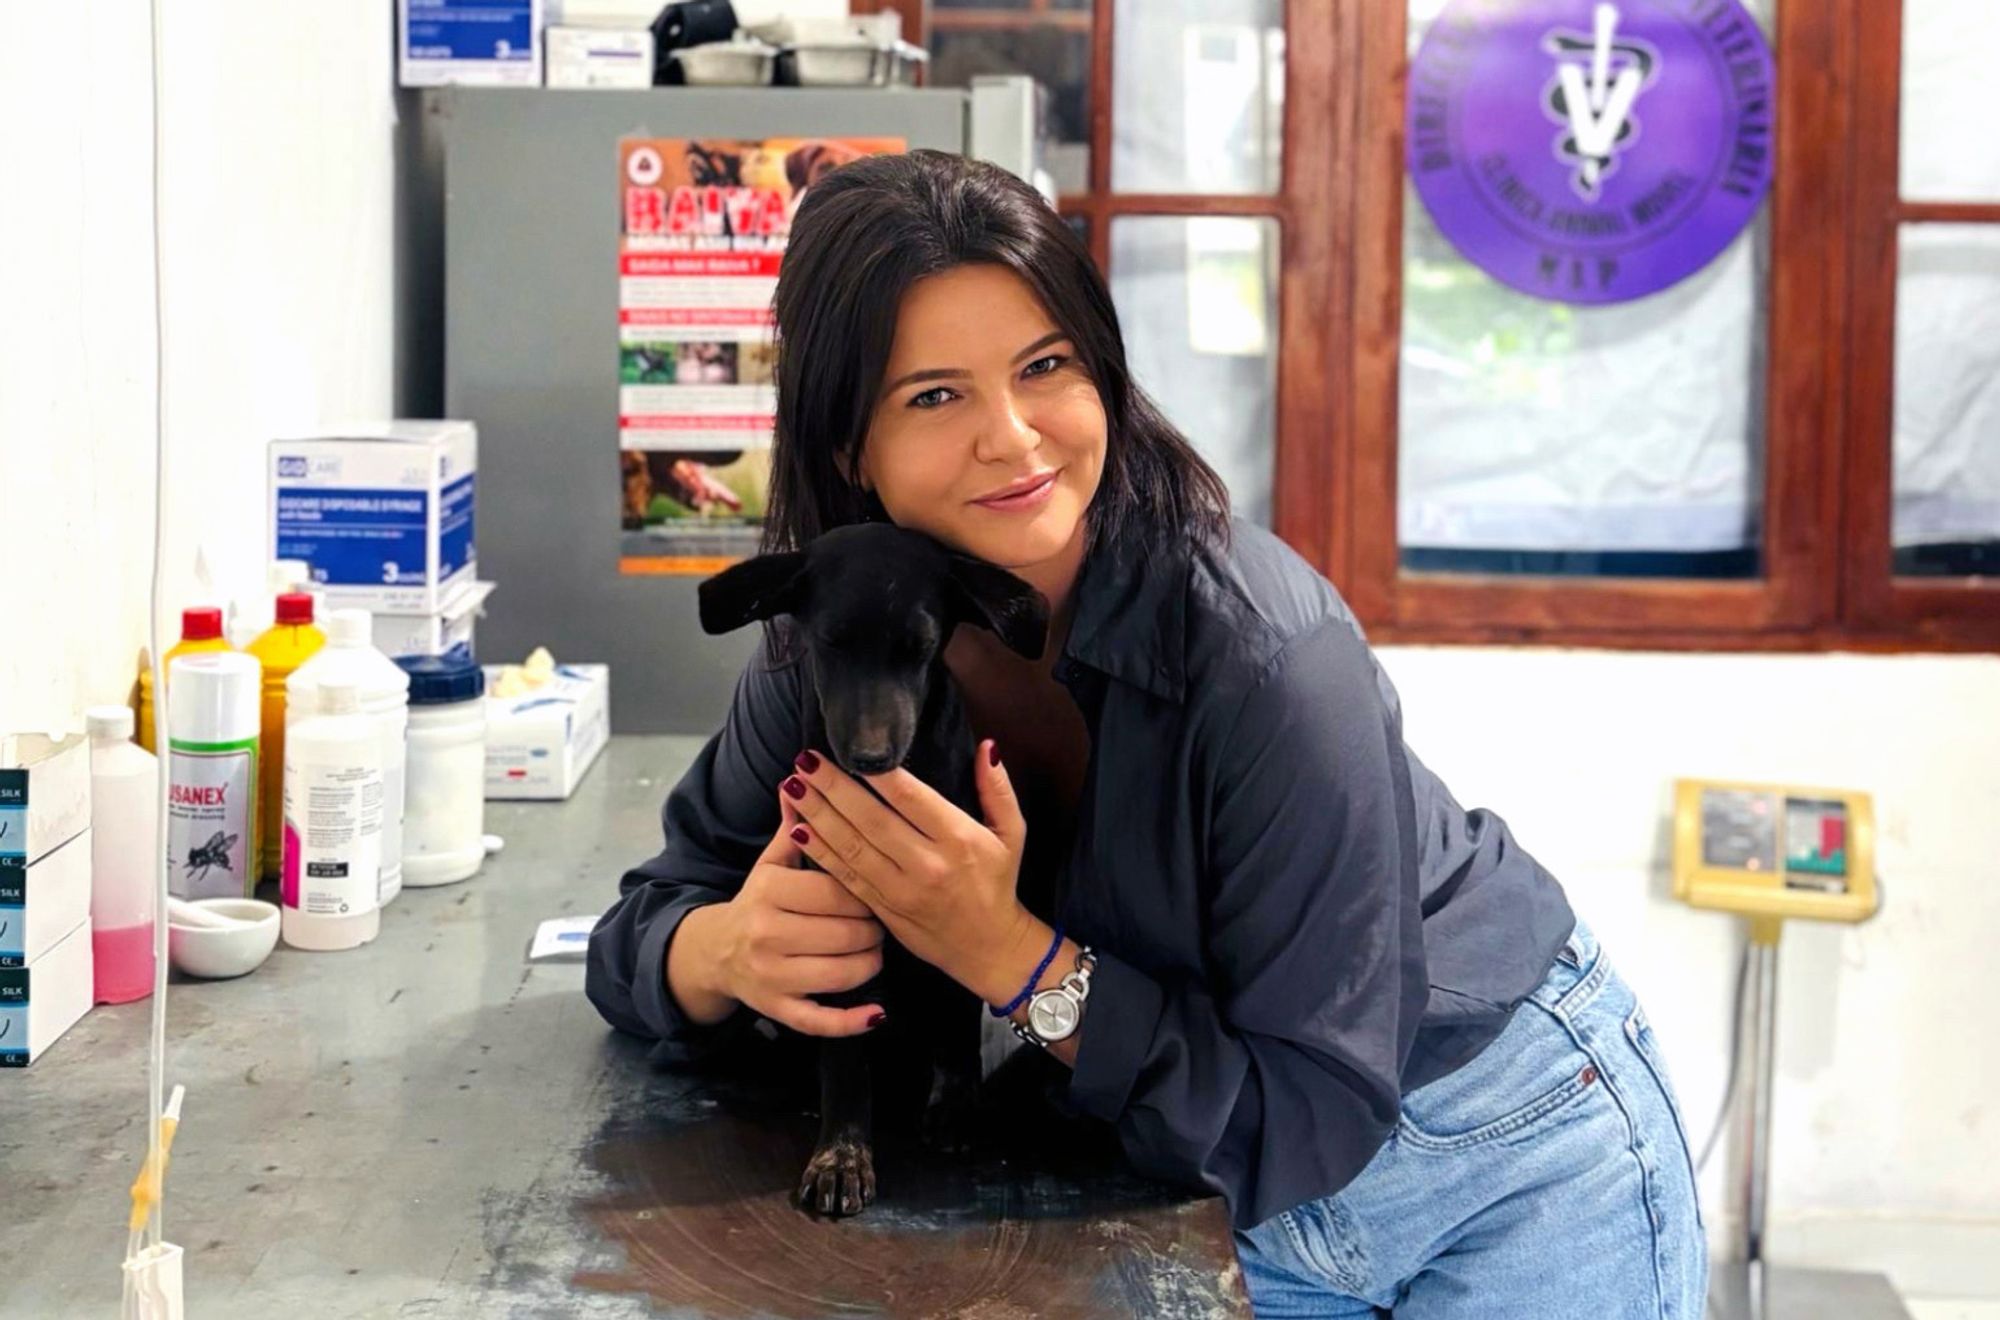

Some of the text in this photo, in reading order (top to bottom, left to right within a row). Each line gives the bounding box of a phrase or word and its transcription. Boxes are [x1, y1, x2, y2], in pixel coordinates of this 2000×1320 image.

[627, 185, 788, 234] RAIVA
[1, 788, 21, 797] SILK
[1, 888, 20, 897] SILK
[2, 987, 23, 996] SILK
